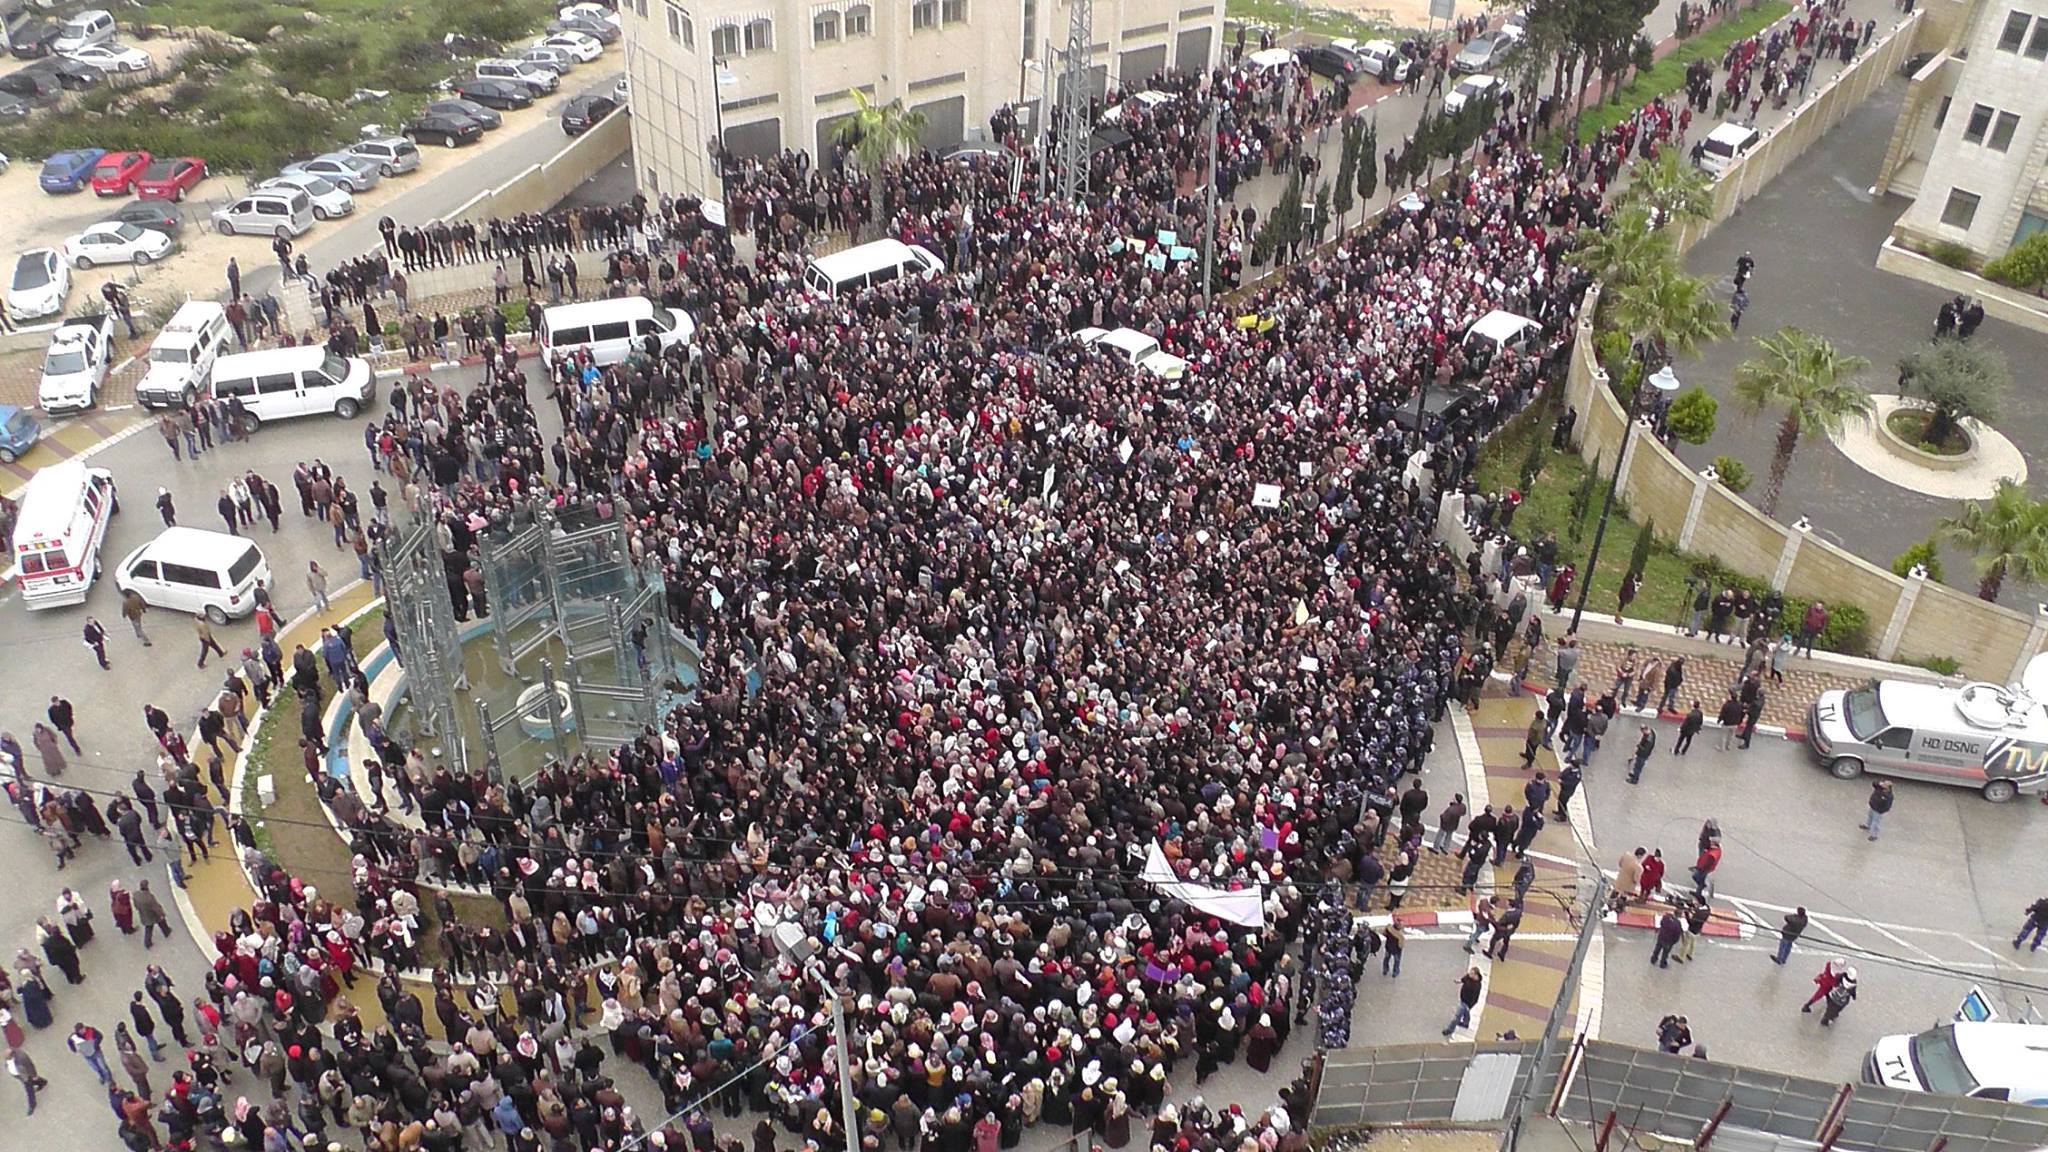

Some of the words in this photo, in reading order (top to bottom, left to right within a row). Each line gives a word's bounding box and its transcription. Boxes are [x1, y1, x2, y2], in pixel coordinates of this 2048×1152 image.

[1819, 703, 1837, 722] TV
[1921, 737, 1941, 749] HD
[1944, 739, 1980, 754] DSNG
[1885, 1055, 1910, 1083] TV
